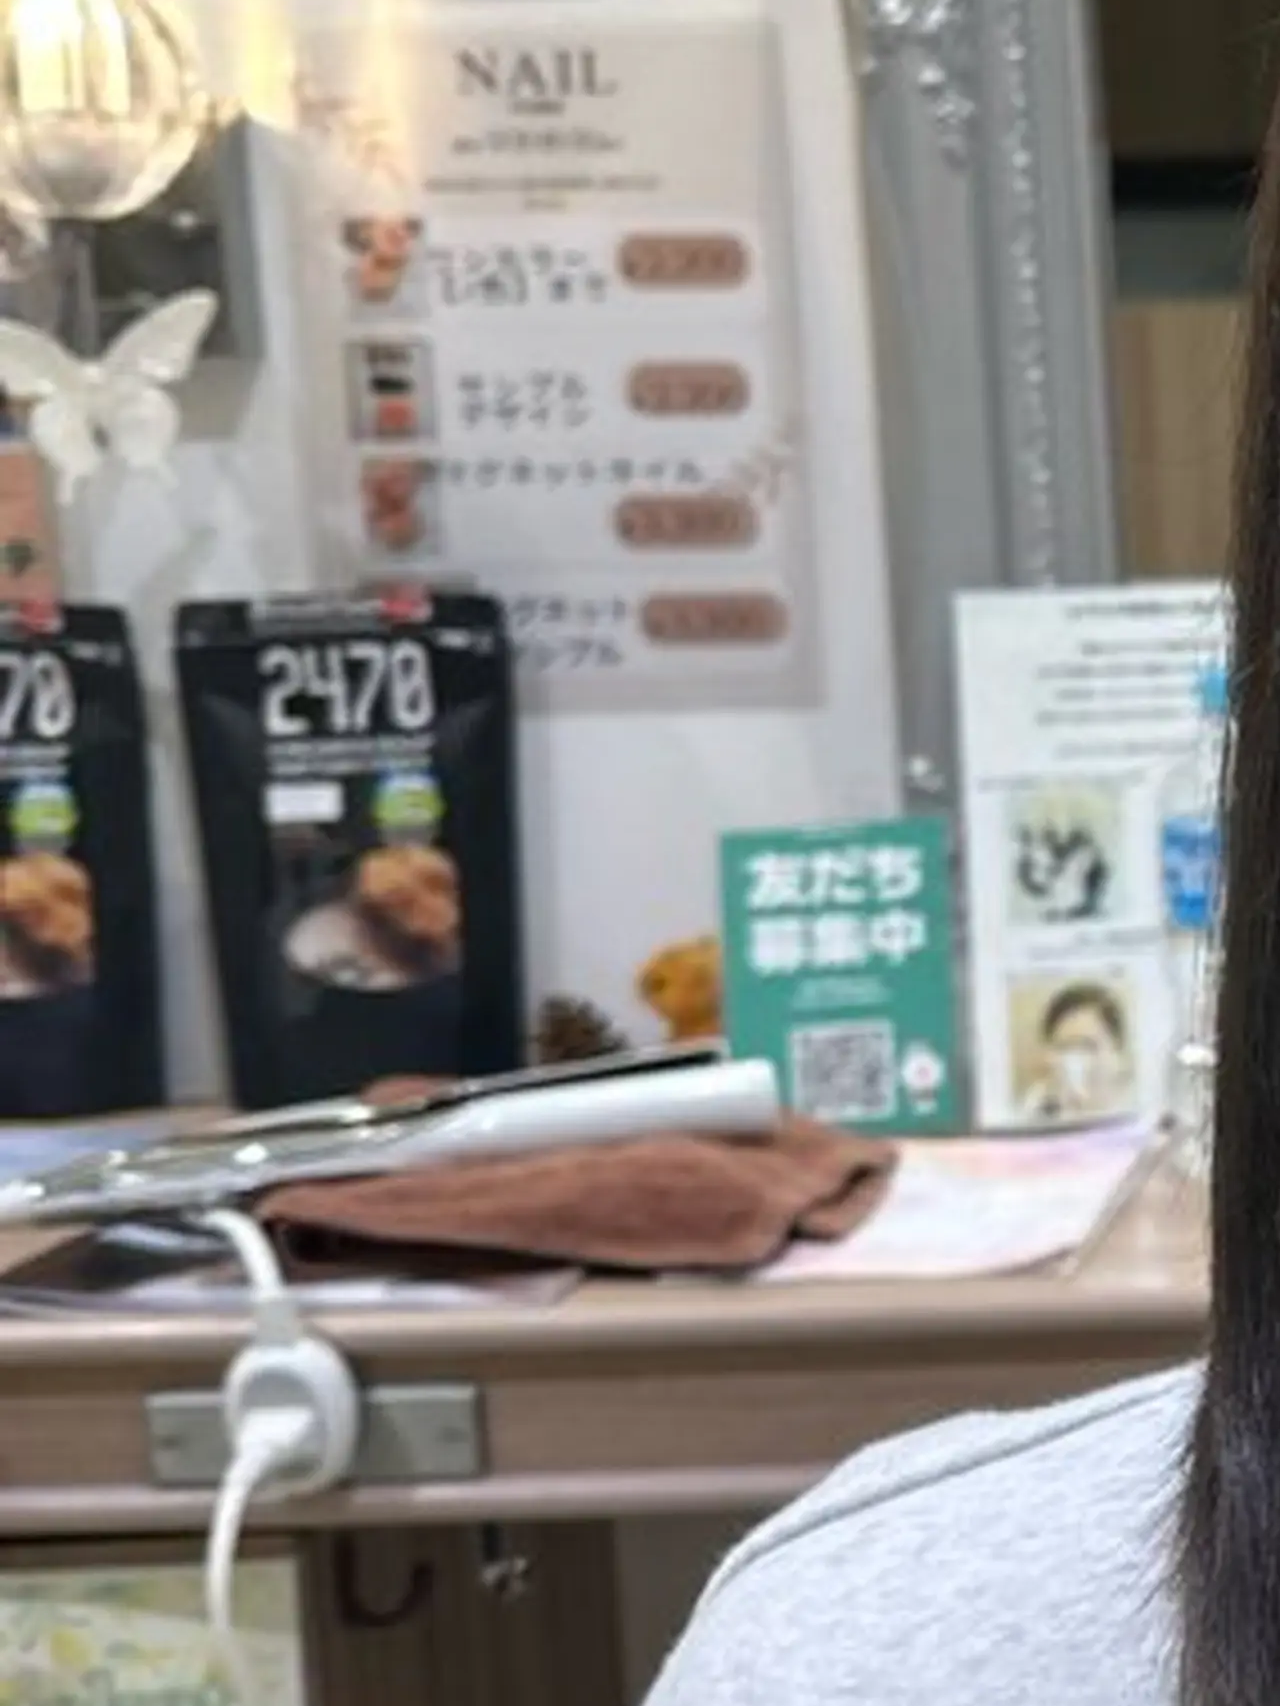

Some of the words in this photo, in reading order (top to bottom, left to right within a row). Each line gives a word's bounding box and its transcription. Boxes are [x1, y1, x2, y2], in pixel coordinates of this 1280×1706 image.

[454, 49, 619, 96] NAIL
[745, 844, 924, 911] 友だち
